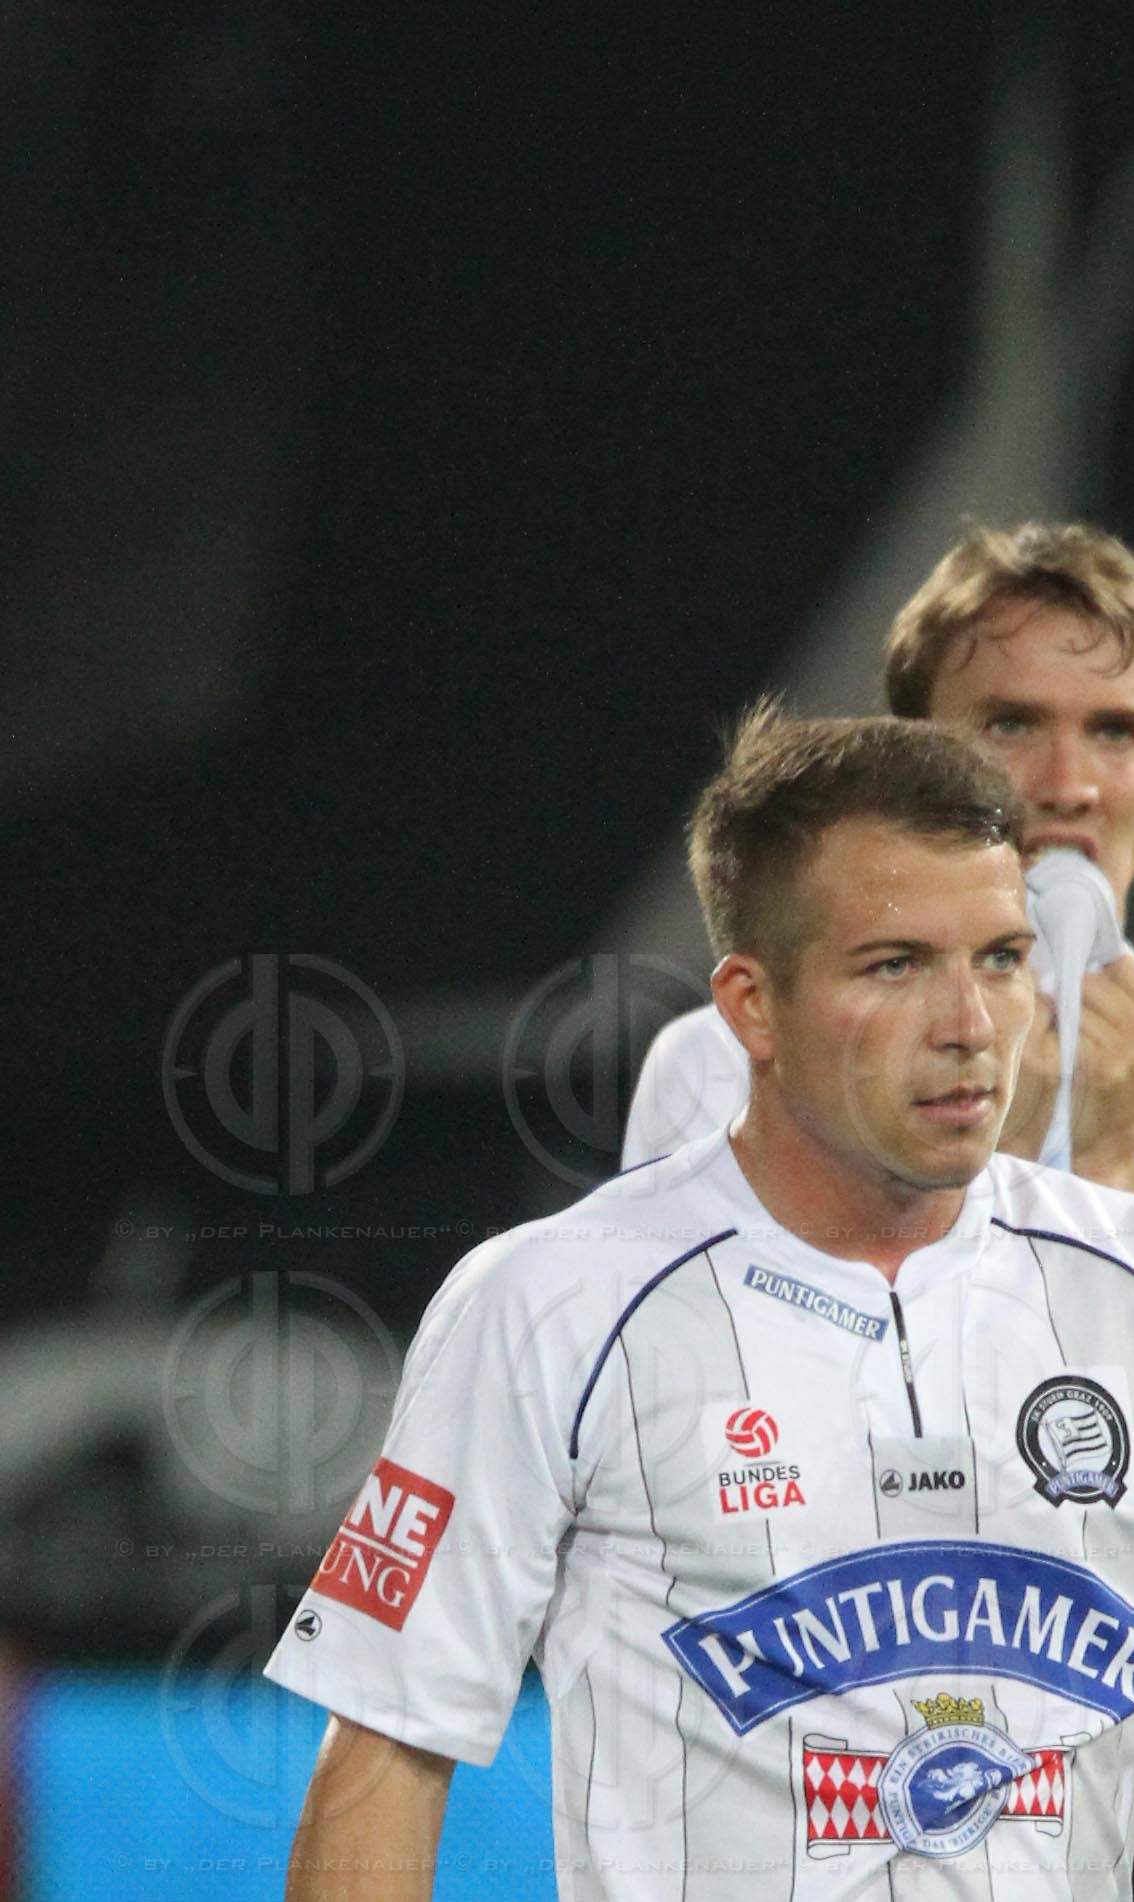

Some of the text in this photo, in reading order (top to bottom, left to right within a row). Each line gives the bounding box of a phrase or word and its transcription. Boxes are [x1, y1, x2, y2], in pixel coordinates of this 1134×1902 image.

[752, 1269, 881, 1339] PUNTIGAMER
[719, 1465, 801, 1487] BUNDES
[908, 1471, 966, 1491] JAKO
[719, 1480, 807, 1515] LIGA
